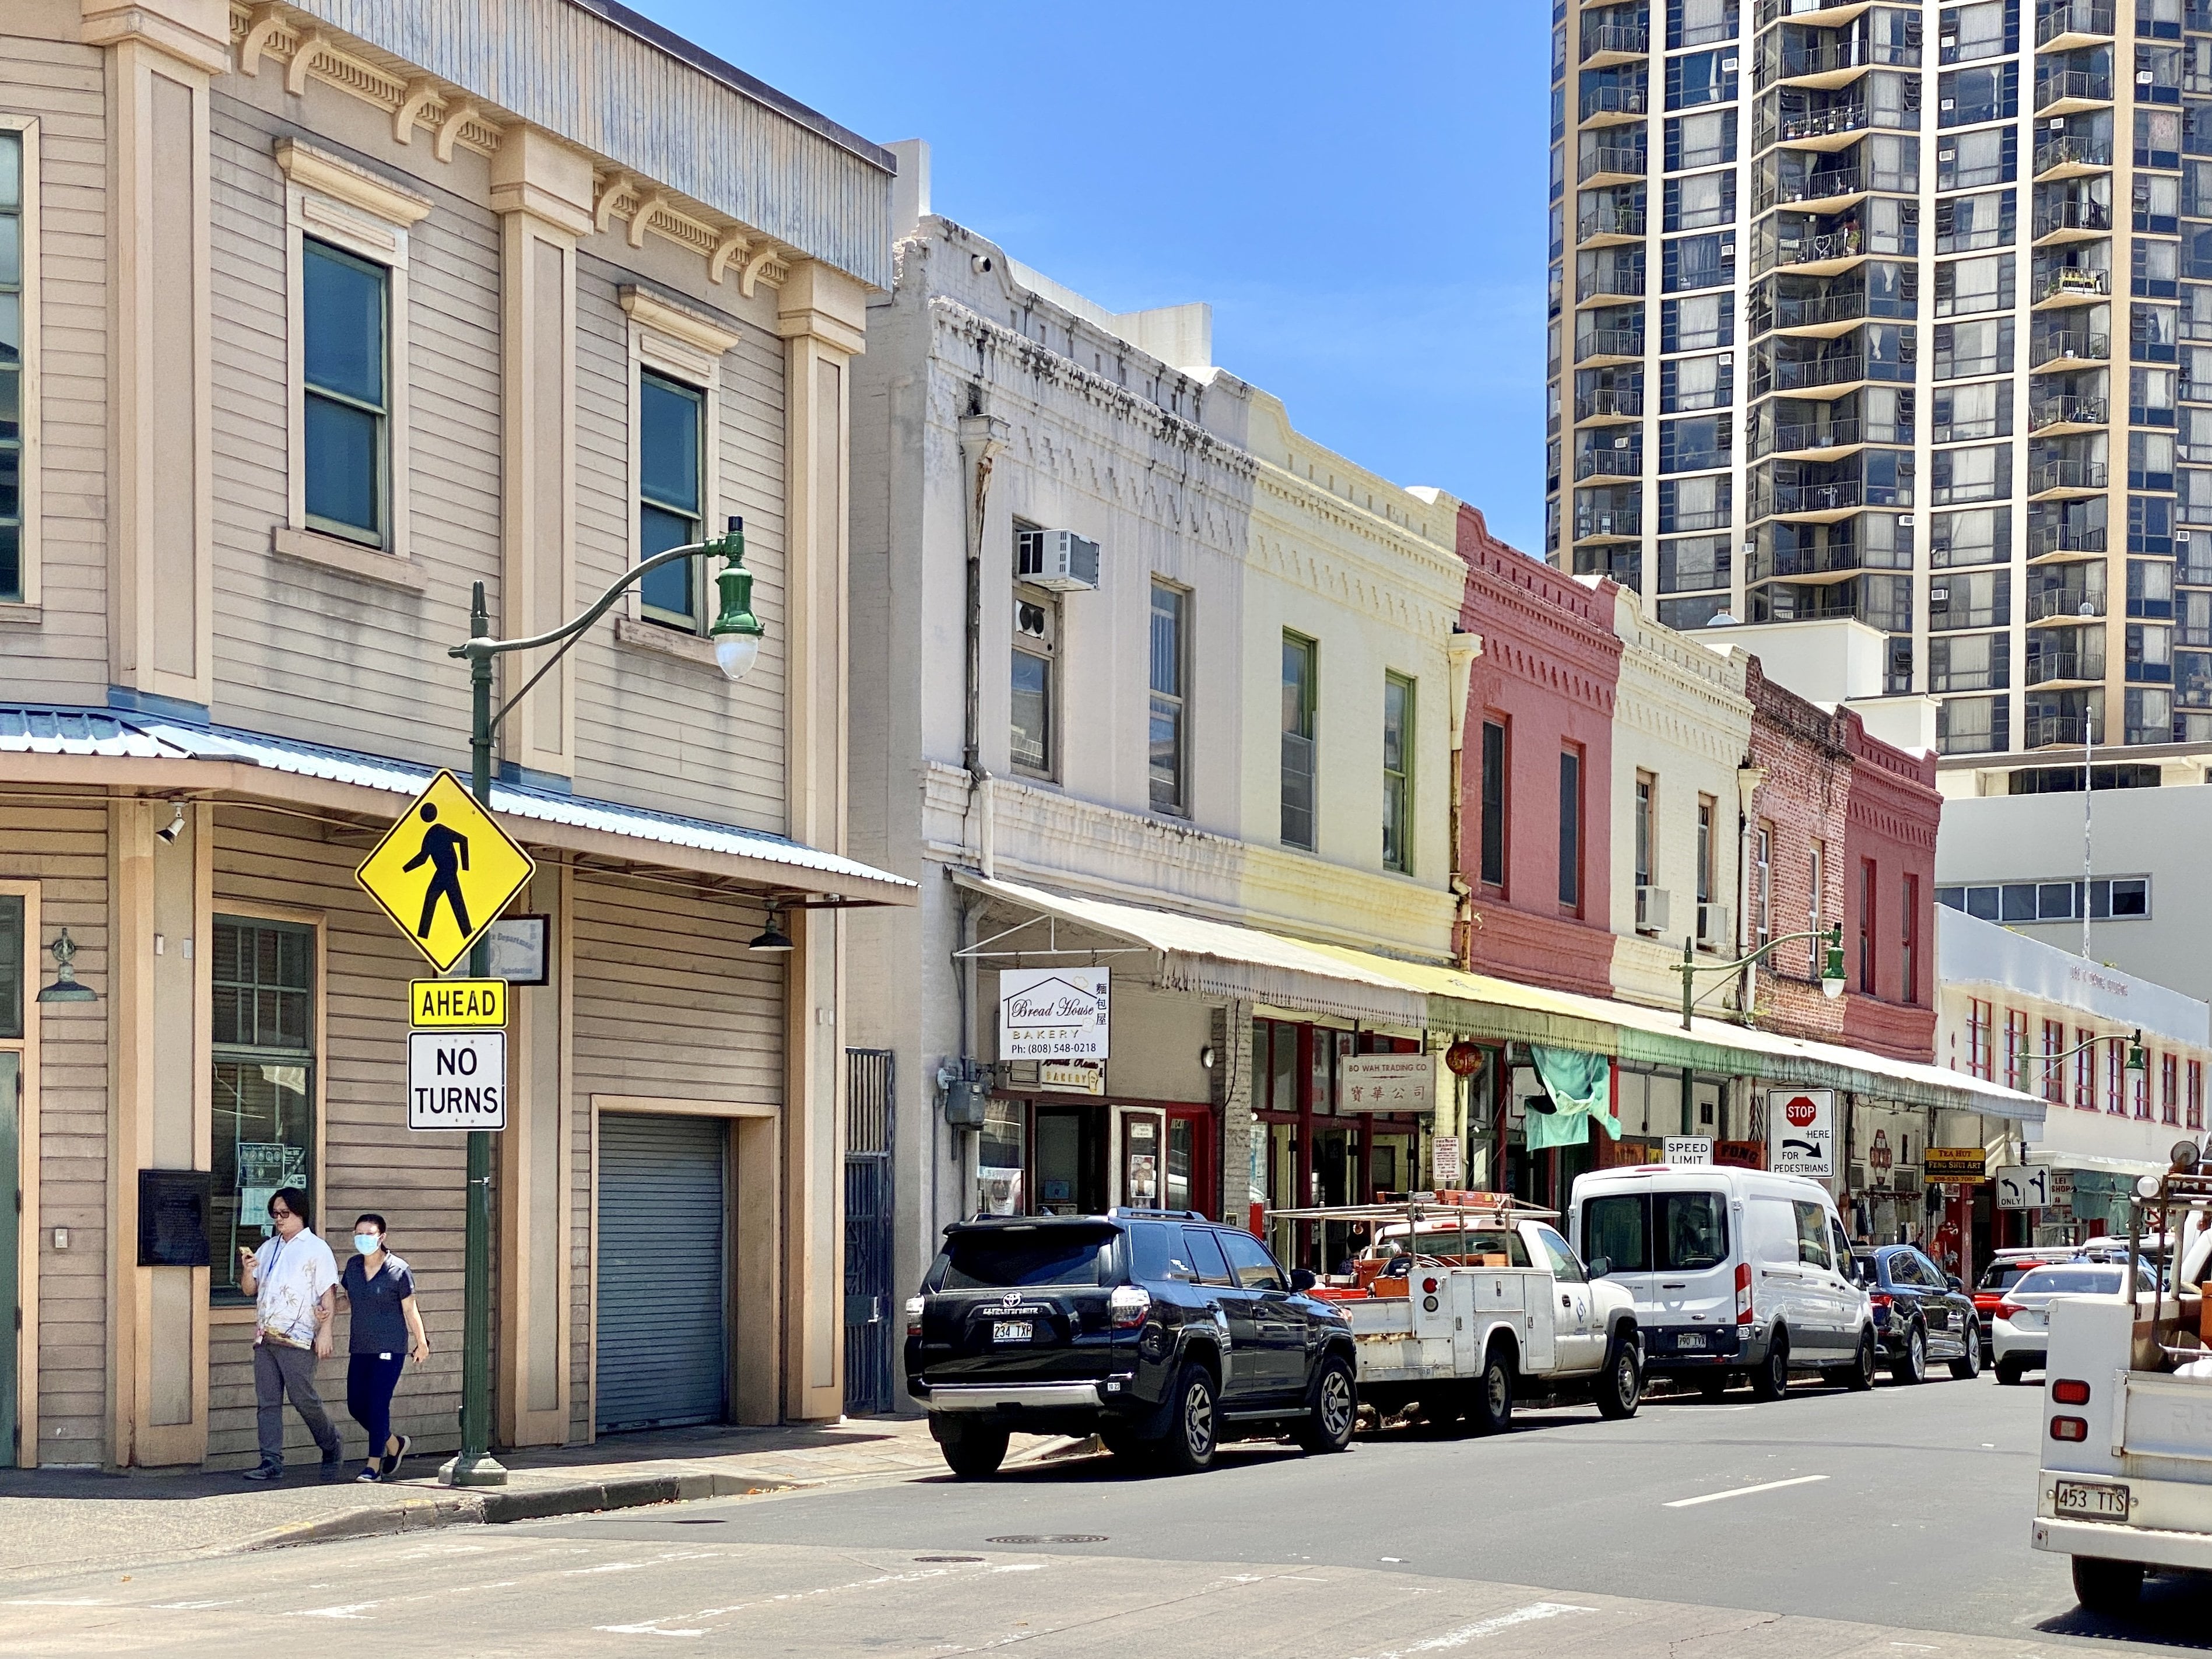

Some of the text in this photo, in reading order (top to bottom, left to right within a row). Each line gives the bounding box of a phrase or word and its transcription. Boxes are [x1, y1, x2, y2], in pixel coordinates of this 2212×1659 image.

[422, 990, 496, 1016] AHEAD
[1012, 997, 1094, 1017] Bread House
[1096, 983, 1107, 1025] 麵包屋
[1012, 1029, 1079, 1039] BAKERY
[1012, 1043, 1096, 1054] Ph: (808) 548-0218
[437, 1047, 477, 1076] NO
[1382, 1064, 1413, 1072] TRADING
[1046, 1071, 1087, 1083] BAKERY
[1351, 1085, 1425, 1102] 寶華公司
[415, 1086, 498, 1114] TURNS
[1788, 1106, 1815, 1118] STOP
[1807, 1130, 1830, 1138] HERE
[1668, 1143, 1708, 1152] SPEED
[1782, 1151, 1799, 1160] FOR
[1938, 1149, 1972, 1158] TEA HUT
[1672, 1156, 1704, 1165] LIMIT
[1774, 1164, 1829, 1173] PEDESTRIANS
[995, 1325, 1032, 1338] 234 TXP
[1679, 1337, 1690, 1345] 790
[2059, 1488, 2124, 1512] 453 TTS
